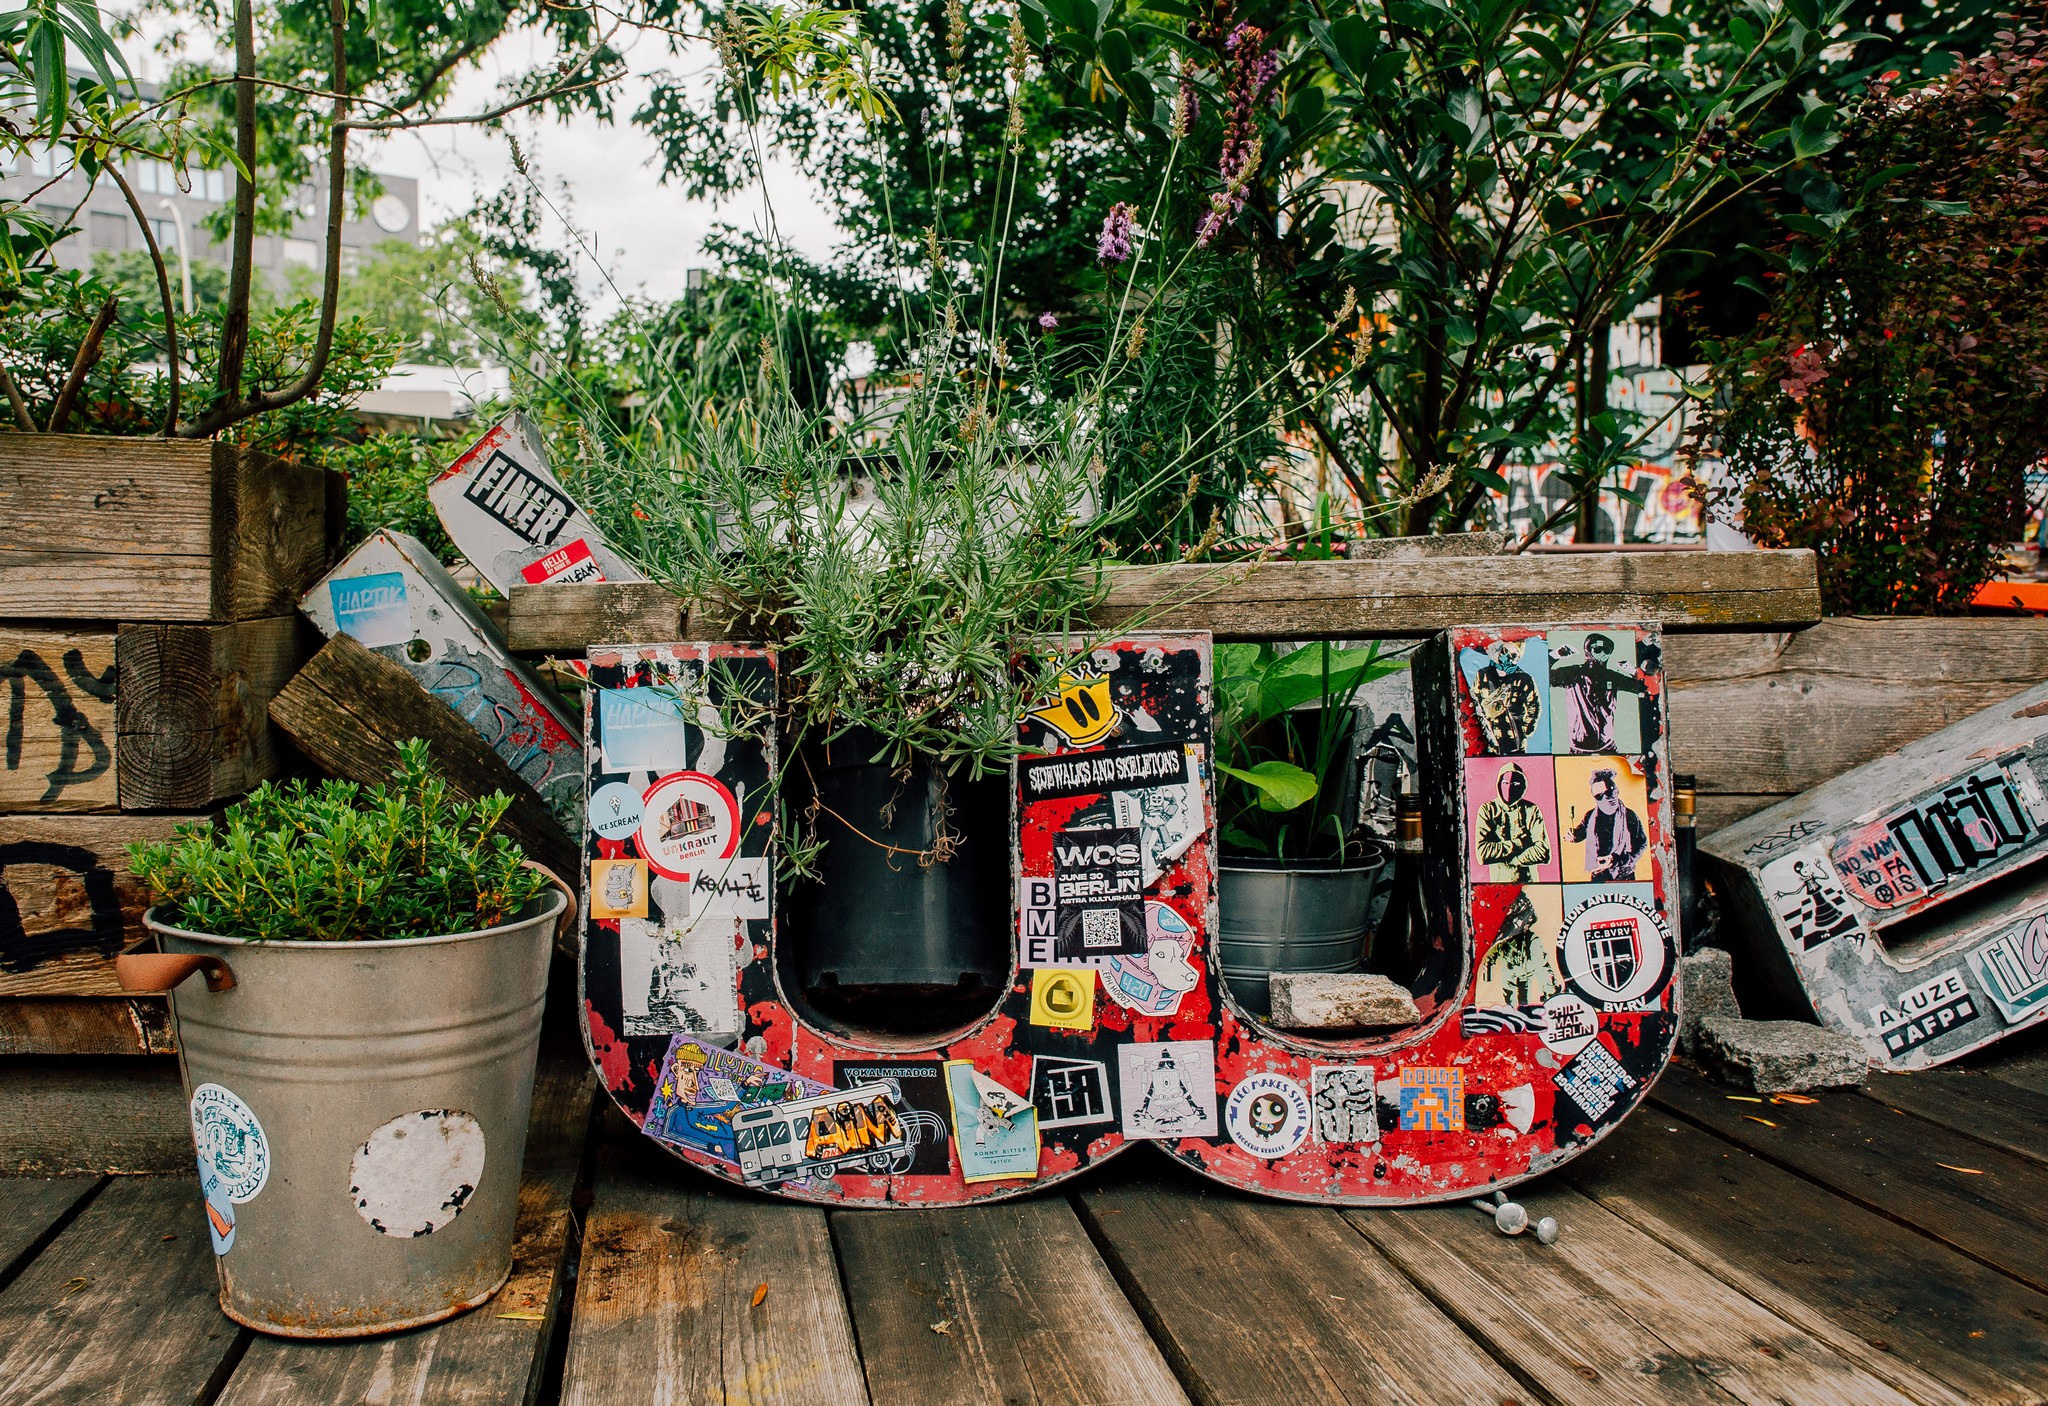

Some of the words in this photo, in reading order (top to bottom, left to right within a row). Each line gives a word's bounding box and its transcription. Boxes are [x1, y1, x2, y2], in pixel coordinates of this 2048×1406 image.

[469, 453, 568, 543] FINER
[541, 550, 568, 571] HELLO
[553, 562, 567, 573] NAME
[1028, 759, 1091, 794] SIDEWALKS
[1092, 756, 1115, 786] AND
[1116, 750, 1180, 782] SKELETONS
[598, 822, 608, 831] ICE
[609, 814, 640, 829] SCREAM
[1056, 843, 1140, 867] WOS
[1059, 873, 1087, 881] JUNE
[1089, 872, 1104, 880] 30
[1116, 869, 1140, 877] 2023
[1836, 856, 1861, 876] NO
[1059, 877, 1140, 897] BERLIN
[1858, 869, 1881, 889] NO
[1088, 894, 1141, 903] KULTURHAUS
[1557, 903, 1587, 950] ACTION
[1587, 893, 1672, 939] ANTIFASCISTE
[1585, 927, 1630, 940] F.C.BVRV
[1110, 984, 1131, 1006] HOODZ
[1122, 975, 1149, 998] 4:20
[1548, 1003, 1584, 1019] CHILL
[1603, 996, 1647, 1013] BV-RV
[1879, 976, 1961, 1027] AKUZE
[1555, 1015, 1582, 1030] MAL
[1906, 1008, 1955, 1044] AFP
[1548, 1024, 1594, 1042] BERLIN
[844, 1068, 937, 1078] VOKALMATADOR
[1571, 1064, 1591, 1082] ART
[1583, 1047, 1618, 1086] FREEDOM
[1589, 1040, 1637, 1089] KNOWLEDGE
[1251, 1078, 1289, 1092] MAKES
[1288, 1090, 1307, 1121] STUFF
[1553, 1072, 1601, 1122] KNOWLEDGE
[1571, 1076, 1608, 1115] FREEDOM
